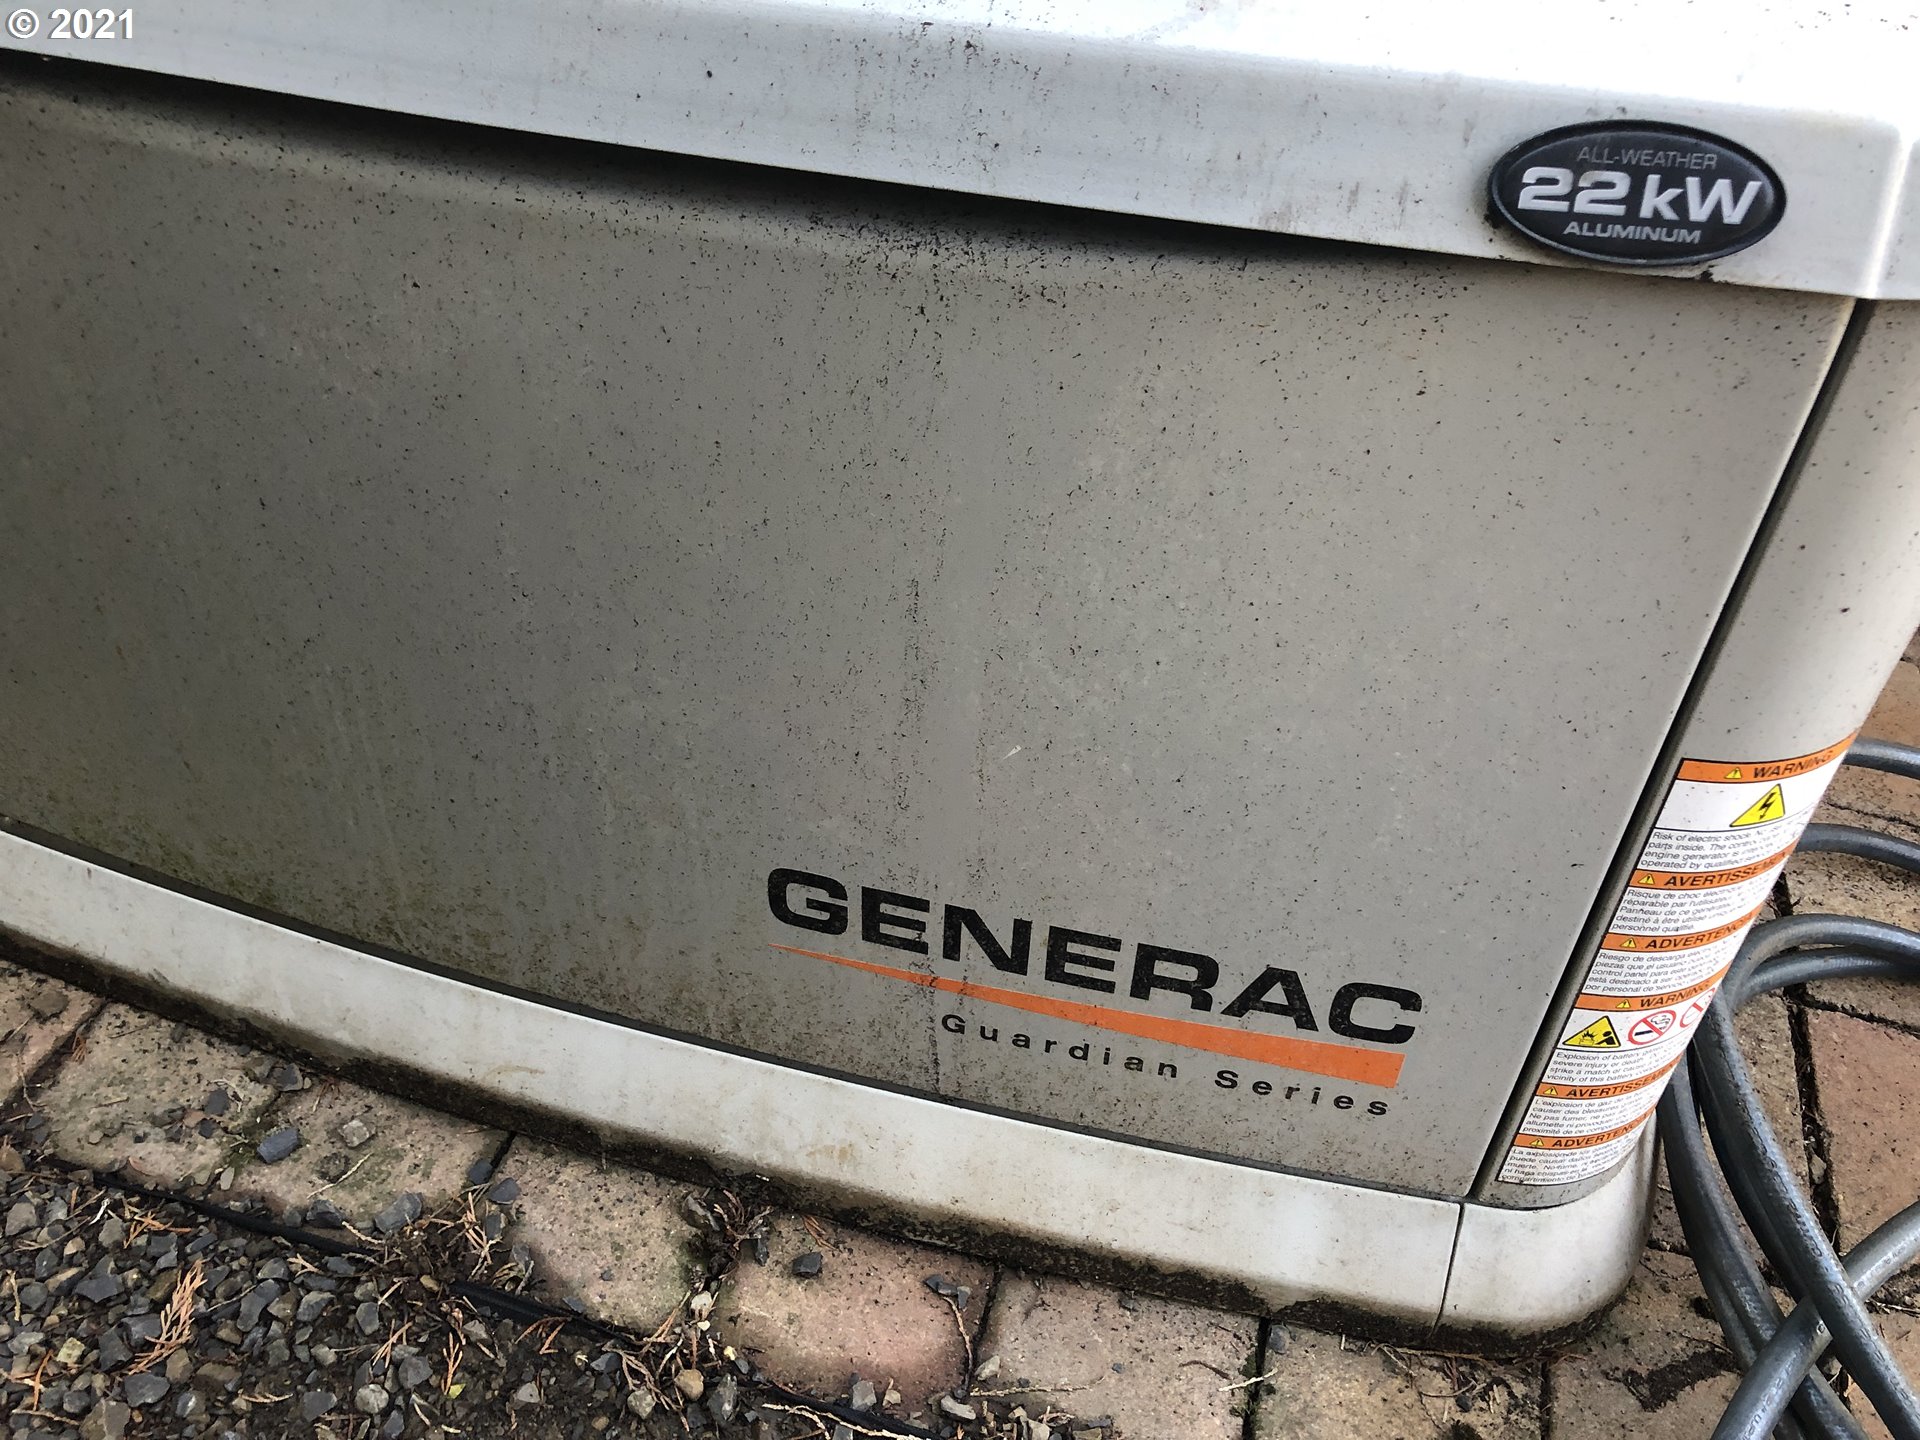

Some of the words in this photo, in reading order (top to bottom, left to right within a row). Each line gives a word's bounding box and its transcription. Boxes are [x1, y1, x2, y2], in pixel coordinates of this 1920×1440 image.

[1576, 146, 1717, 170] ALL-WEATHER
[1517, 166, 1631, 216] 22
[1639, 174, 1764, 225] kW
[1563, 221, 1701, 244] ALUMINUM
[1753, 750, 1833, 778] WARNING
[1653, 832, 1674, 841] Risk
[1676, 834, 1687, 842] of
[1688, 834, 1722, 843] electric
[1648, 842, 1673, 852] parts
[1675, 843, 1706, 852] inside.
[1710, 843, 1727, 851] The
[1645, 850, 1680, 861] engine
[1682, 851, 1730, 862] generator
[1641, 859, 1687, 870] operated
[1689, 861, 1701, 871] by
[1627, 889, 1661, 901] Risque
[1663, 892, 1677, 900] de
[1678, 891, 1701, 900] choc
[1671, 900, 1688, 909] par
[1619, 906, 1664, 916] Panneau
[1664, 908, 1677, 916] de
[1678, 908, 1691, 916] ce
[1611, 923, 1660, 934] personnel
[767, 867, 1423, 1045] GENERAC
[1599, 952, 1632, 963] Riesgo
[1632, 954, 1645, 962] de
[1595, 961, 1624, 971] piezas
[1627, 963, 1644, 972] que
[1592, 969, 1622, 978] control
[1624, 970, 1649, 979] panel
[1588, 976, 1607, 984] está
[1609, 977, 1651, 985] destinado
[1585, 984, 1601, 992] por
[1602, 985, 1641, 994] personal
[1642, 985, 1654, 993] de
[1556, 1052, 1600, 1061] Explosion
[1602, 1053, 1612, 1061] of
[940, 1013, 1179, 1080] Guardian
[1214, 1069, 1389, 1117] Series
[1585, 1060, 1608, 1069] injury
[1550, 1066, 1574, 1075] strike
[1584, 1067, 1611, 1075] match
[1547, 1074, 1577, 1083] vicinity
[1578, 1075, 1589, 1083] of
[1590, 1075, 1605, 1083] this
[1529, 1112, 1542, 1120] Ne
[1532, 1107, 1562, 1115] causer
[1509, 1155, 1537, 1163] puede
[1514, 1167, 1536, 1177] haga
